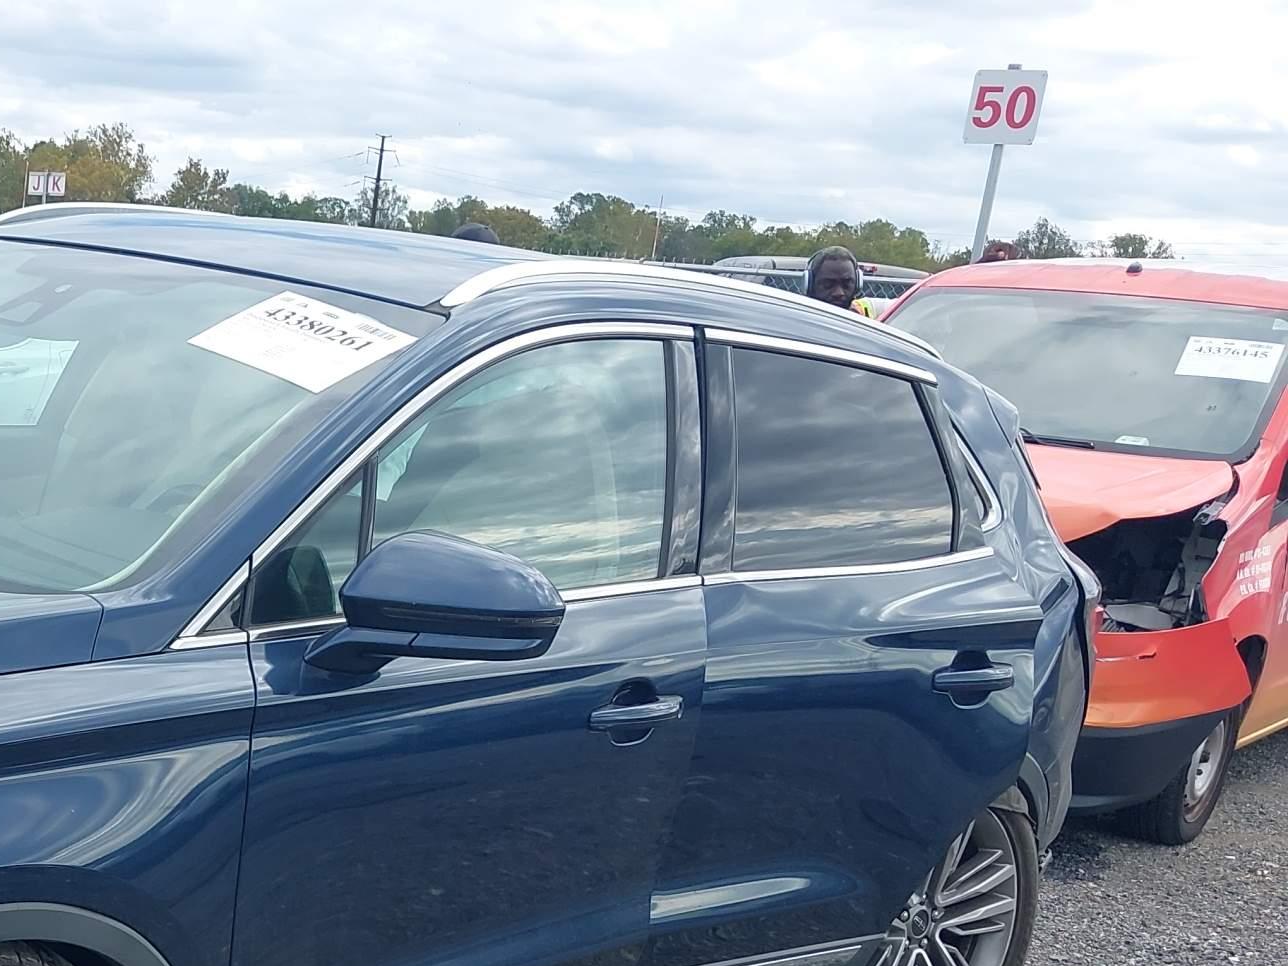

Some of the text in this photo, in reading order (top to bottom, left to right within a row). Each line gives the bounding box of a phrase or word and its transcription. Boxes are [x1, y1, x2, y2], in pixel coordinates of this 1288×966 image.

[972, 86, 1037, 129] 50
[33, 175, 41, 191] J
[52, 175, 62, 192] K
[264, 307, 373, 351] 43380261
[1194, 346, 1270, 359] 43376145
